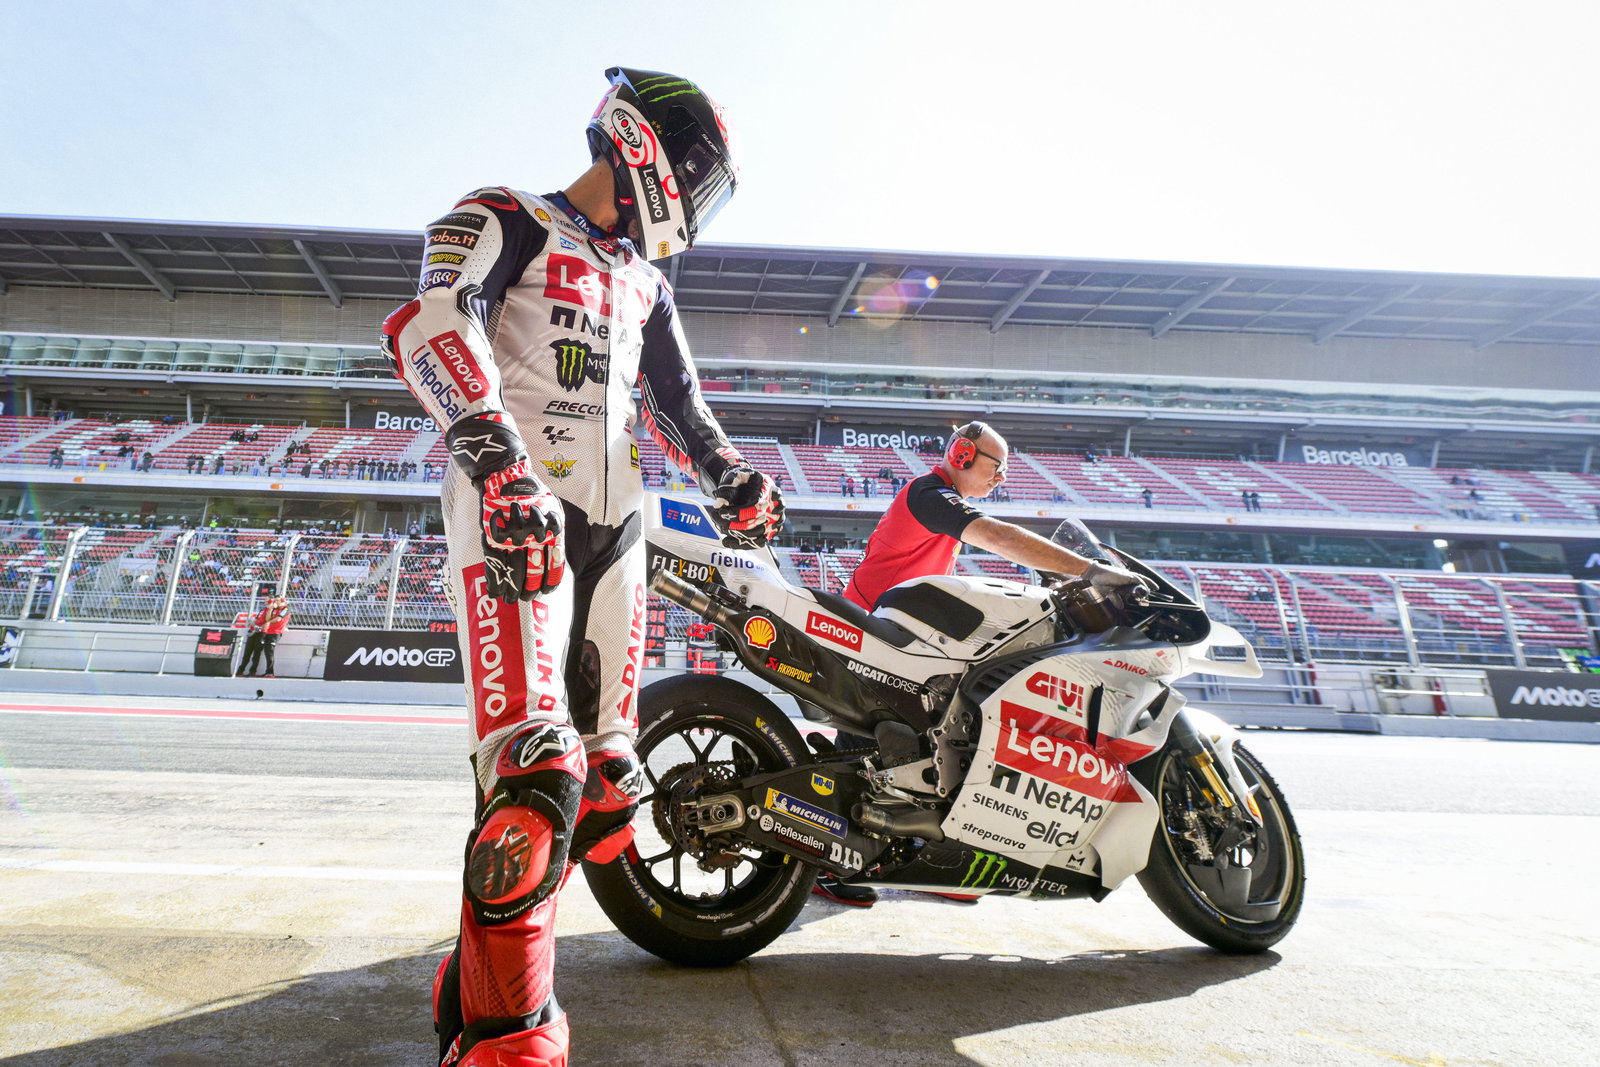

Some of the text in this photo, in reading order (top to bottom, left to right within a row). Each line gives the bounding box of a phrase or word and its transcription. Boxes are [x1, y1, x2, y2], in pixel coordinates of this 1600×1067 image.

[615, 109, 638, 147] SUOMY
[642, 168, 665, 219] Lenovo
[428, 229, 476, 247] ruba.it
[574, 214, 590, 234] TIM
[420, 271, 459, 292] LEX-BOX
[438, 337, 483, 393] Lenovo
[411, 344, 467, 423] UnipolSai
[375, 411, 444, 432] Barce
[546, 400, 604, 416] FRECCI
[1302, 445, 1408, 467] Barcelona
[680, 511, 701, 526] TIM
[651, 554, 716, 583] FLEX-BOX
[711, 552, 754, 569] riello
[621, 582, 645, 688] DAIKO
[811, 616, 860, 645] Lenovo
[343, 646, 456, 668] MotoGP
[474, 575, 507, 718] Lenovo
[1114, 660, 1149, 676] DAIKO
[1026, 671, 1085, 710] GIVI
[1510, 685, 1600, 708] MotoG
[769, 732, 797, 768] MICHEL
[1007, 718, 1118, 787] Lenov
[972, 792, 1030, 822] SIEMENS
[1023, 777, 1104, 824] NetAp
[789, 804, 842, 831] MICHELIN
[773, 821, 826, 852] Reflexallen
[961, 822, 1027, 850] streparava
